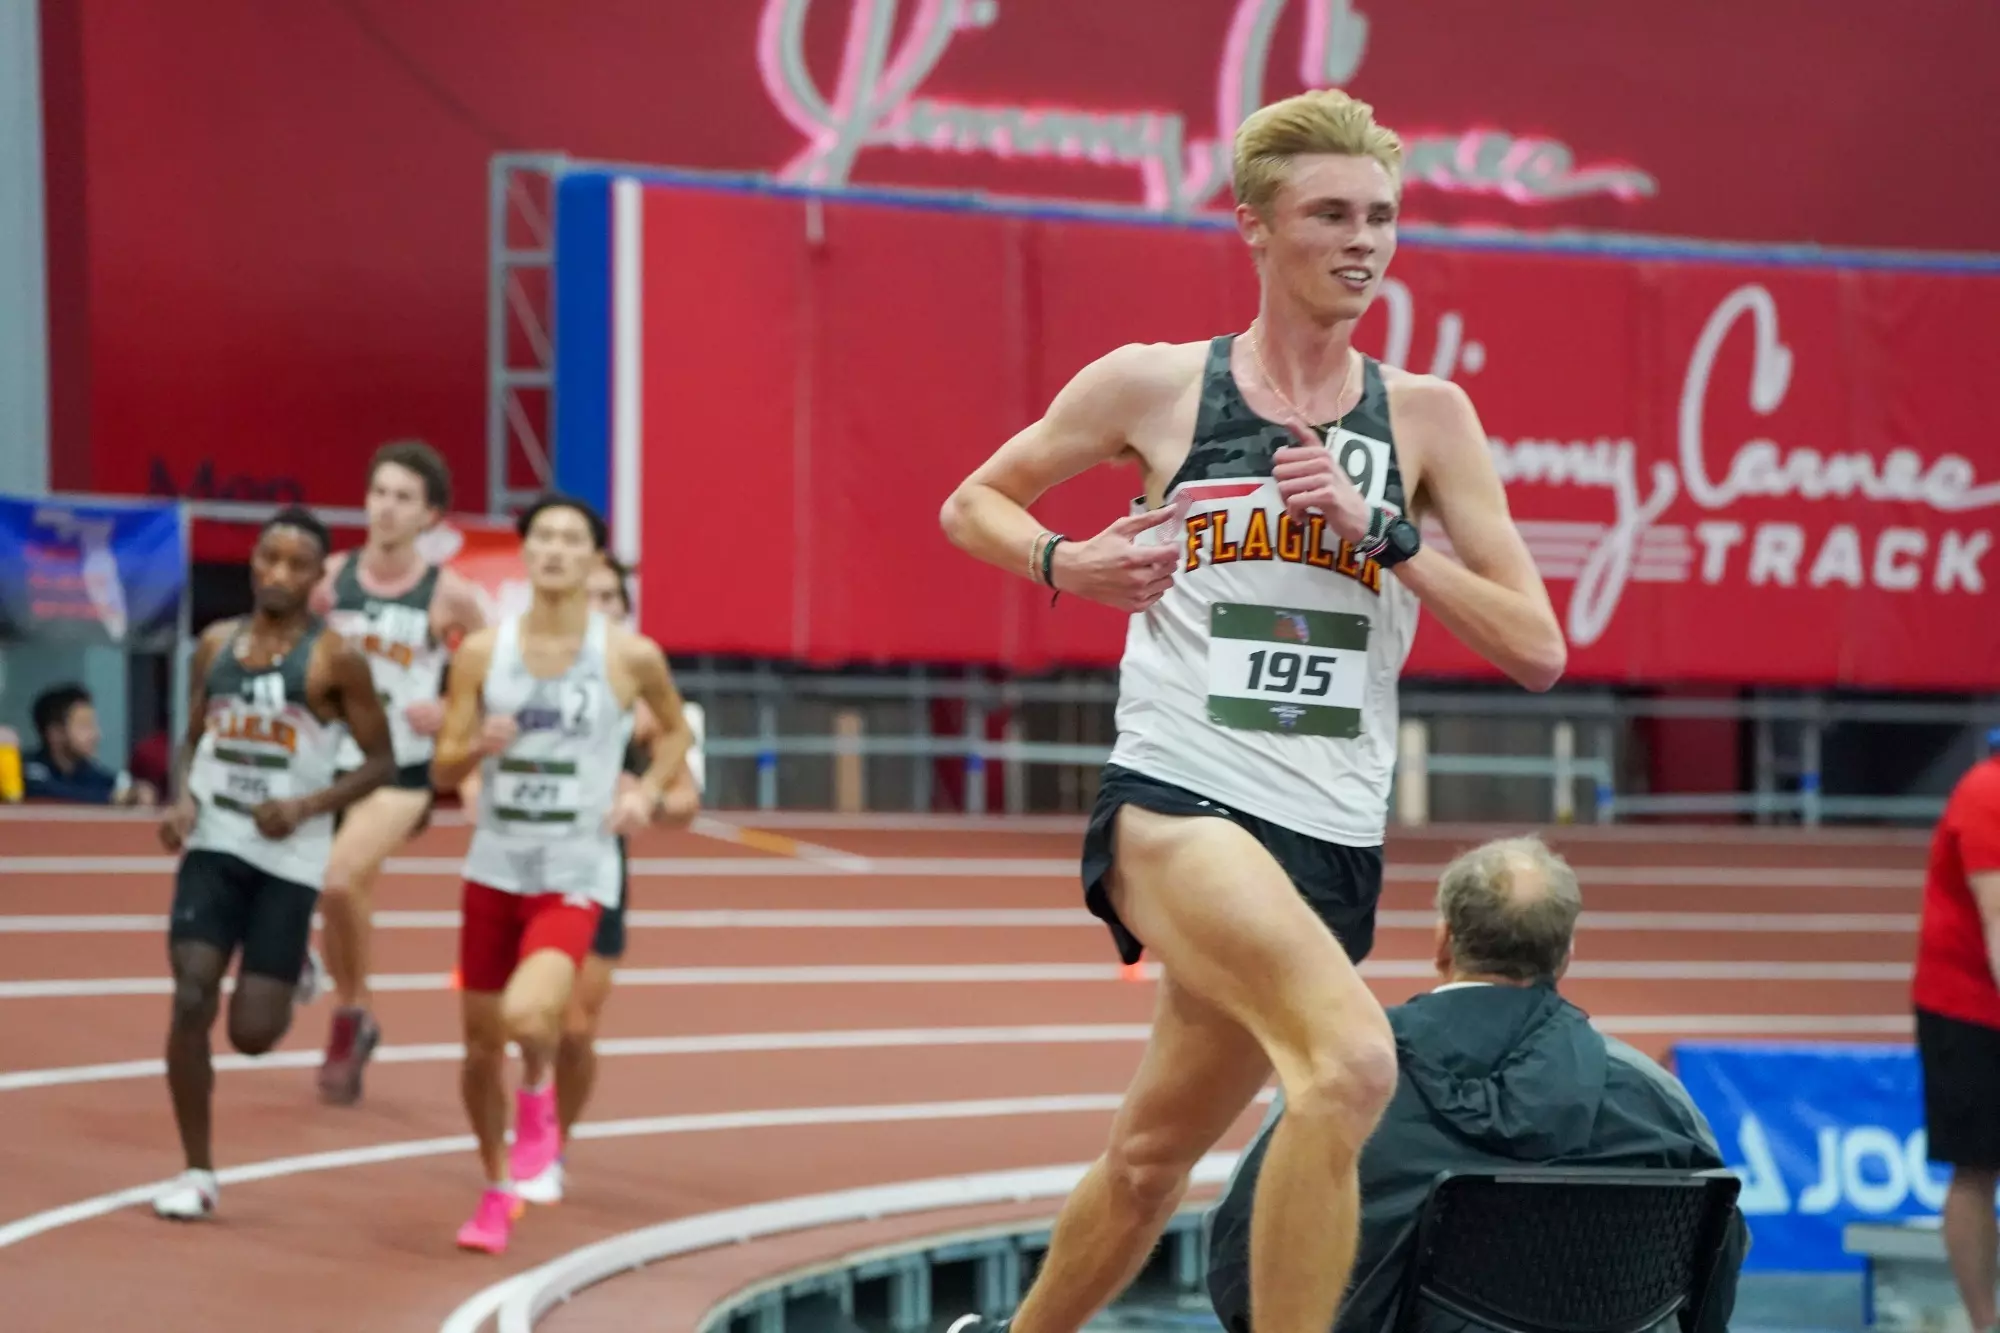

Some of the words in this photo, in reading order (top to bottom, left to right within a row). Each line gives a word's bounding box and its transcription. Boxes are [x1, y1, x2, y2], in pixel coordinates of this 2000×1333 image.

[1338, 438, 1373, 499] 9
[1698, 519, 1990, 593] TRACK
[1247, 650, 1338, 697] 195
